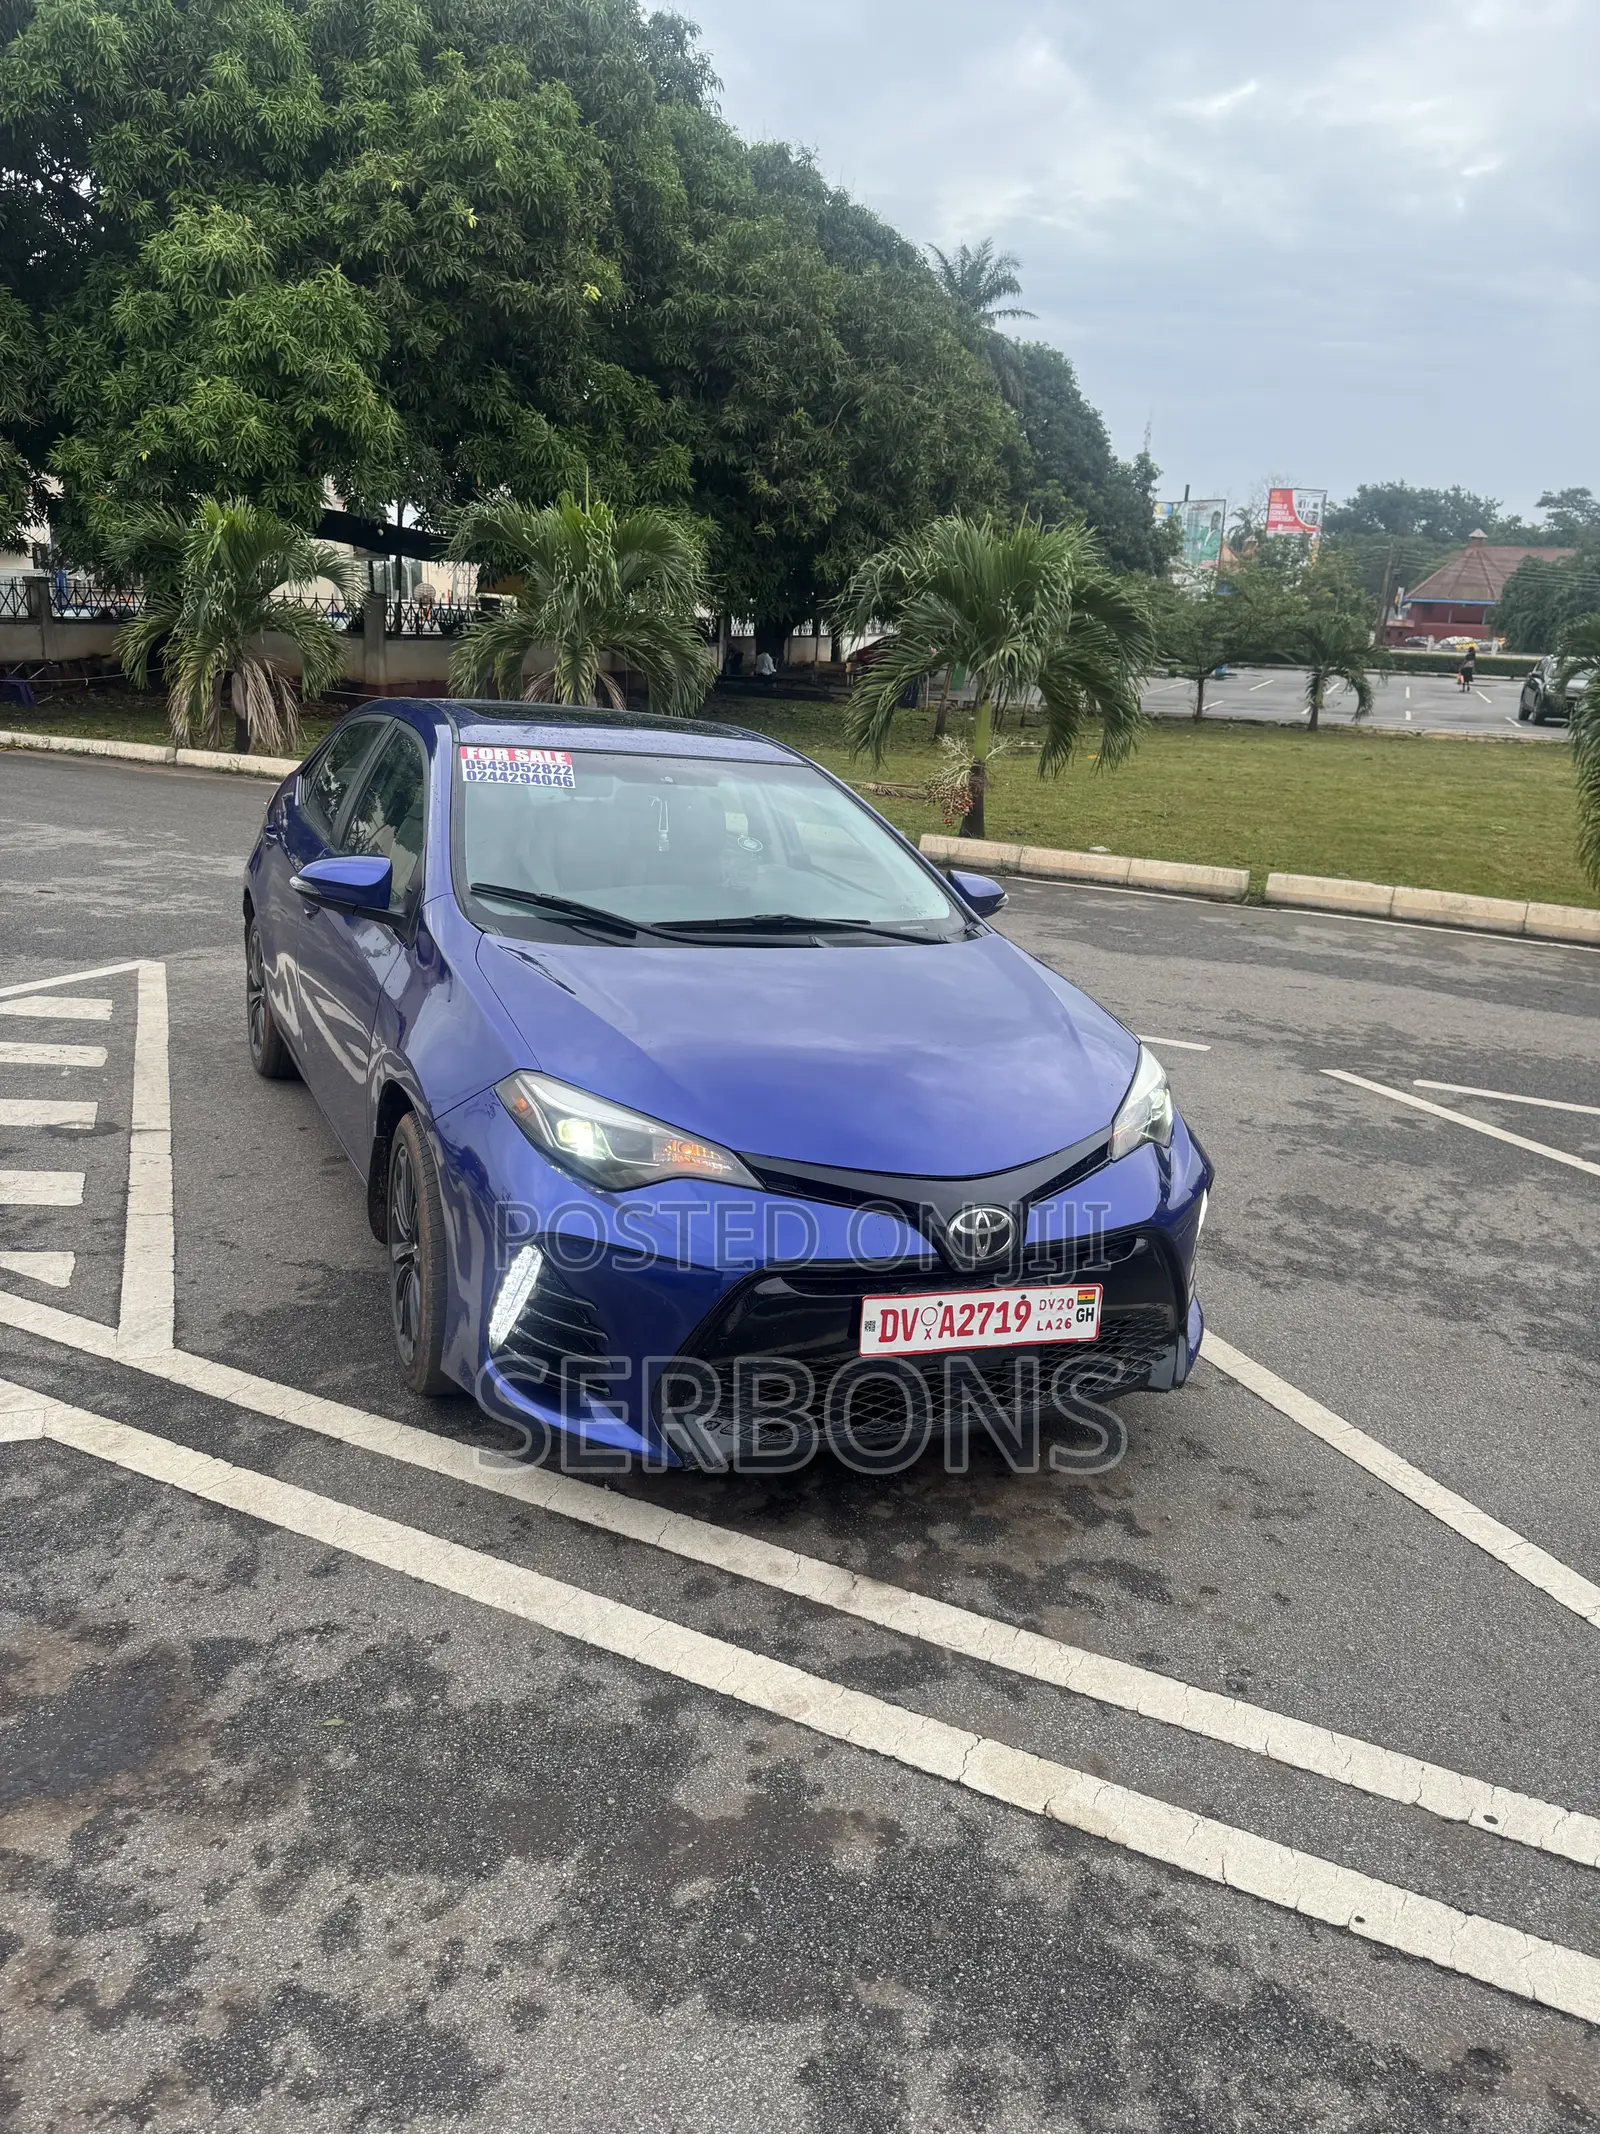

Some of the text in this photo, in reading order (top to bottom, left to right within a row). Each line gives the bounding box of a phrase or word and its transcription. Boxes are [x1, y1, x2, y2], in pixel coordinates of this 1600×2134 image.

[466, 748, 568, 765] FOR SALE
[465, 760, 573, 776] 0543052822
[466, 771, 574, 787] 0244294046
[1039, 1297, 1075, 1312] DV20
[878, 1300, 1033, 1343] DV A2719
[1075, 1307, 1095, 1323] GH
[1036, 1316, 1072, 1332] LA26
